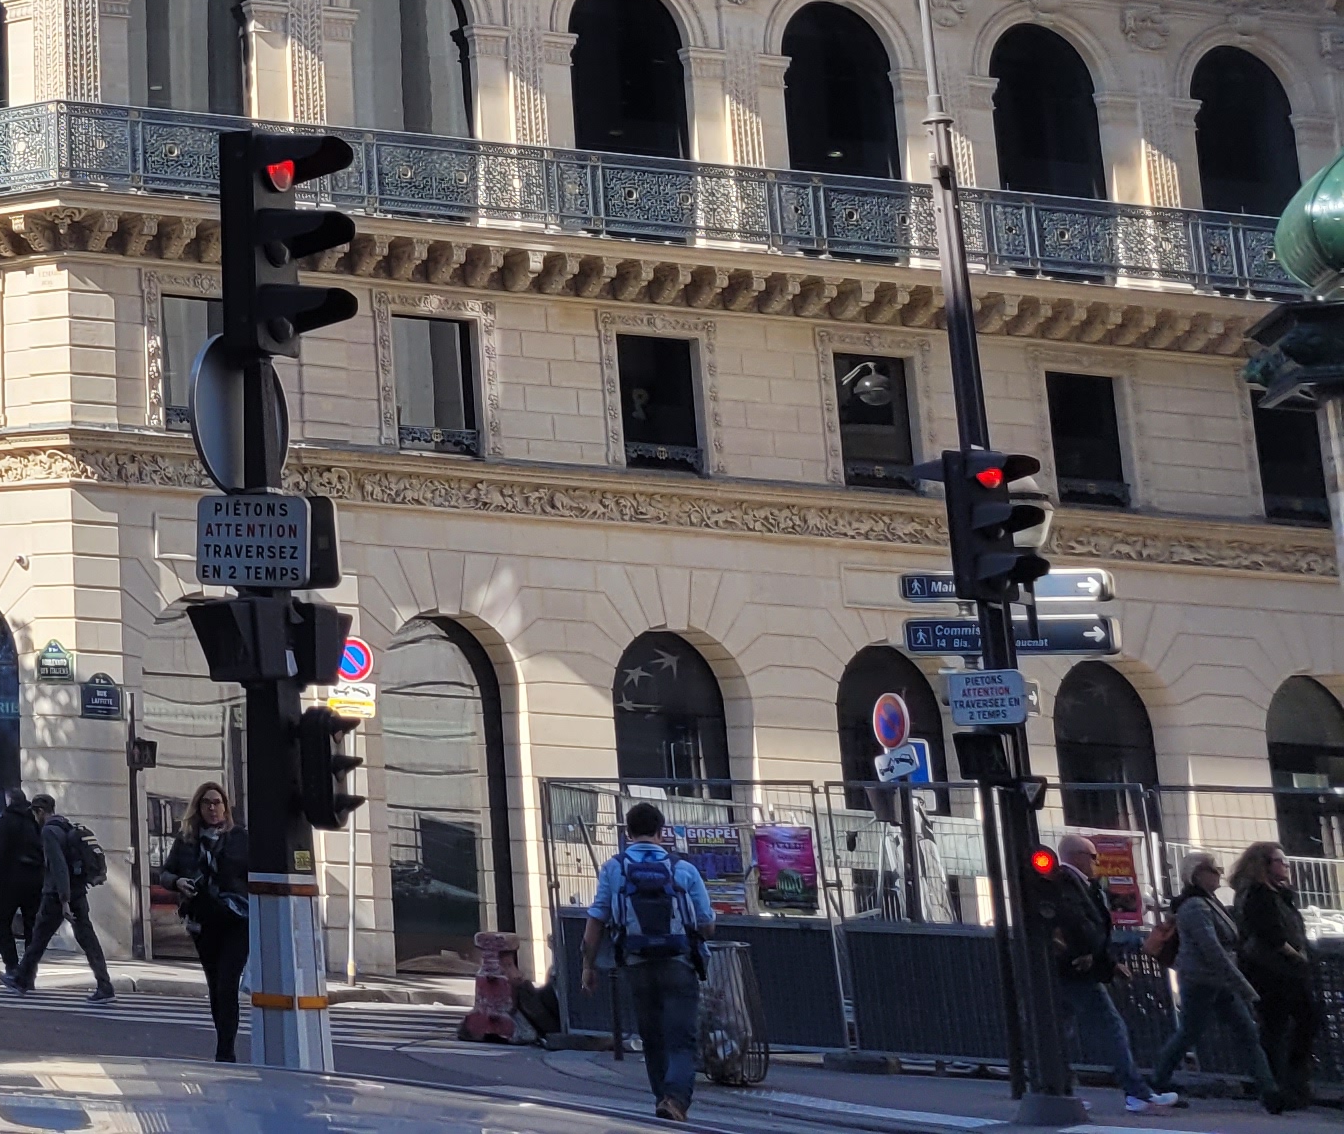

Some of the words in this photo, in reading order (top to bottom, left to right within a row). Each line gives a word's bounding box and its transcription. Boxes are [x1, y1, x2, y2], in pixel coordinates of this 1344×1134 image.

[214, 499, 288, 516] PIÉTONS
[205, 523, 297, 538] ATTENTION
[204, 544, 299, 560] TRAVERSEZ
[202, 564, 221, 579] EN
[228, 565, 237, 579] 2
[244, 566, 299, 581] TEMPS
[962, 686, 1010, 698] ATTENTION
[953, 697, 1006, 709] TRAVERSEZ
[1008, 697, 1020, 707] EN
[968, 711, 975, 720] 2
[977, 709, 1007, 720] TEMPS
[686, 827, 739, 839] GOSPEL
